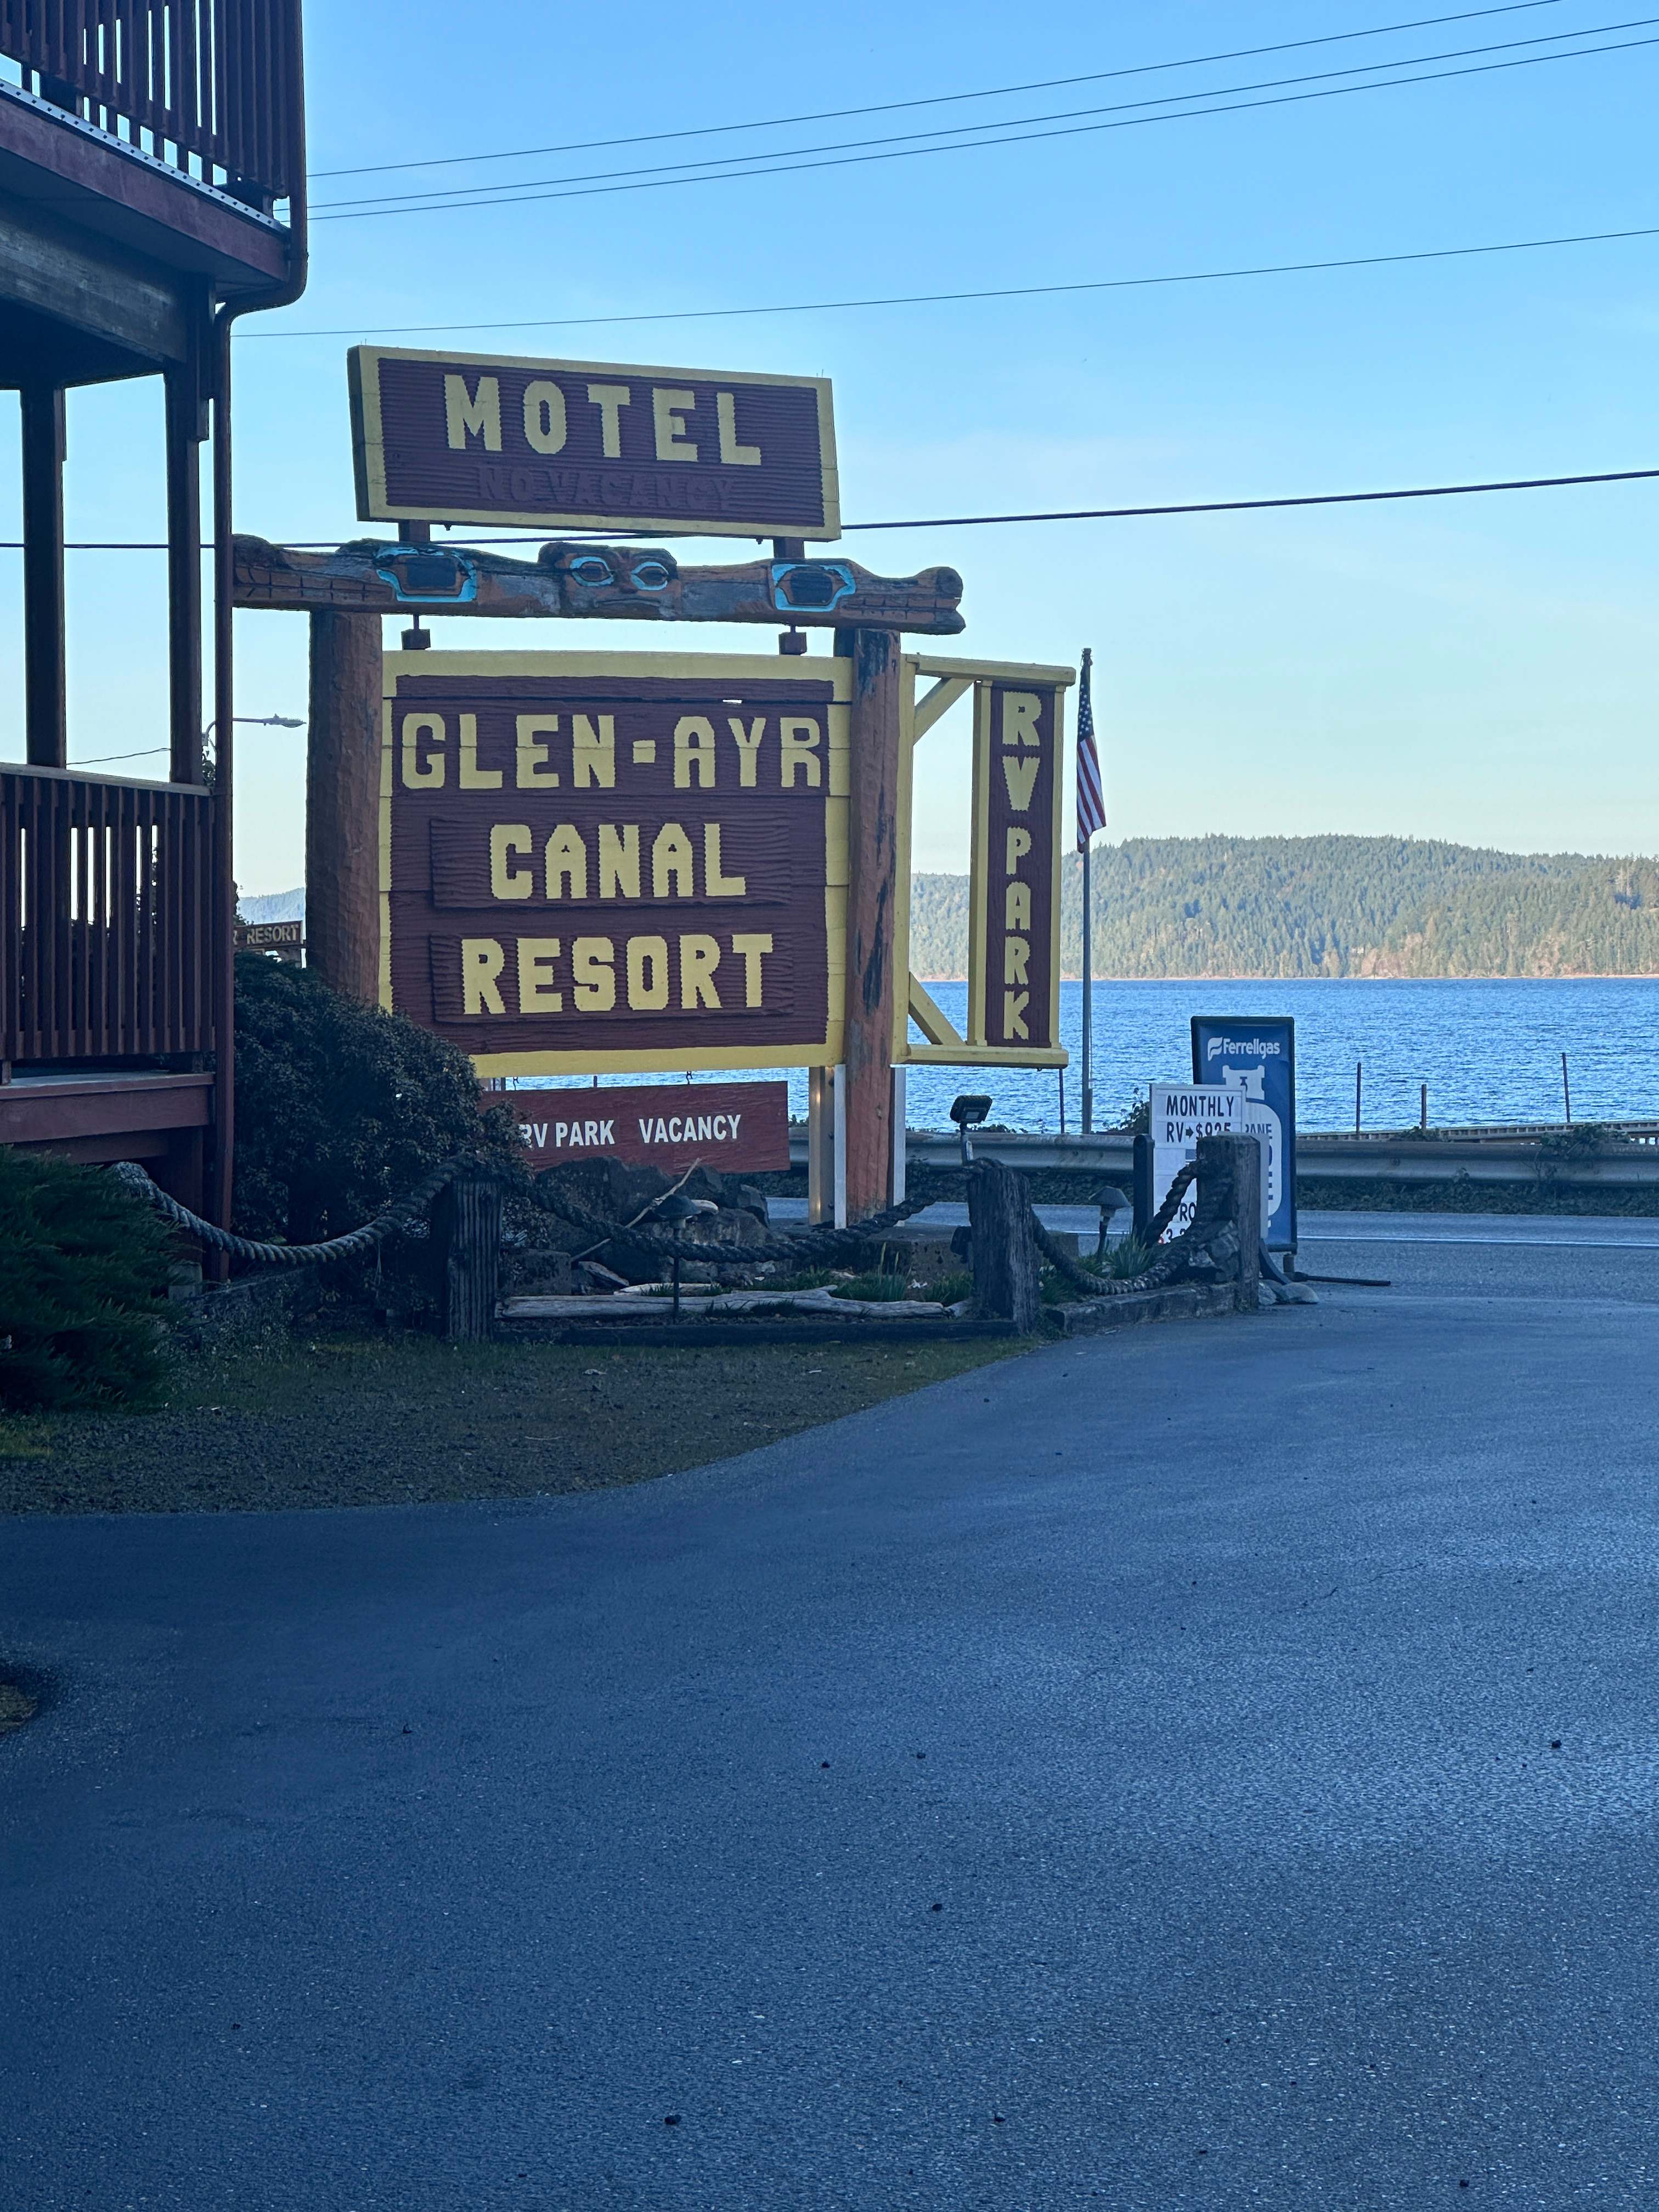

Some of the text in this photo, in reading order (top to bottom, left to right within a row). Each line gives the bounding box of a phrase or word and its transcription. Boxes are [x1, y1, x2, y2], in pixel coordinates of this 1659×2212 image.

[444, 374, 762, 465] MOTEL
[478, 465, 732, 511] NO VACANCY
[402, 713, 821, 789] GLEN-AYR
[490, 823, 746, 899] CANAL
[1002, 691, 1042, 1040] RV PARK
[247, 924, 298, 945] RESORT
[462, 934, 773, 1014] RESORT
[1223, 1038, 1280, 1058] Ferrellgas
[1166, 1096, 1234, 1117] MONTHLY
[519, 1114, 741, 1148] RV PARK VACANCY
[1166, 1122, 1184, 1143] RV
